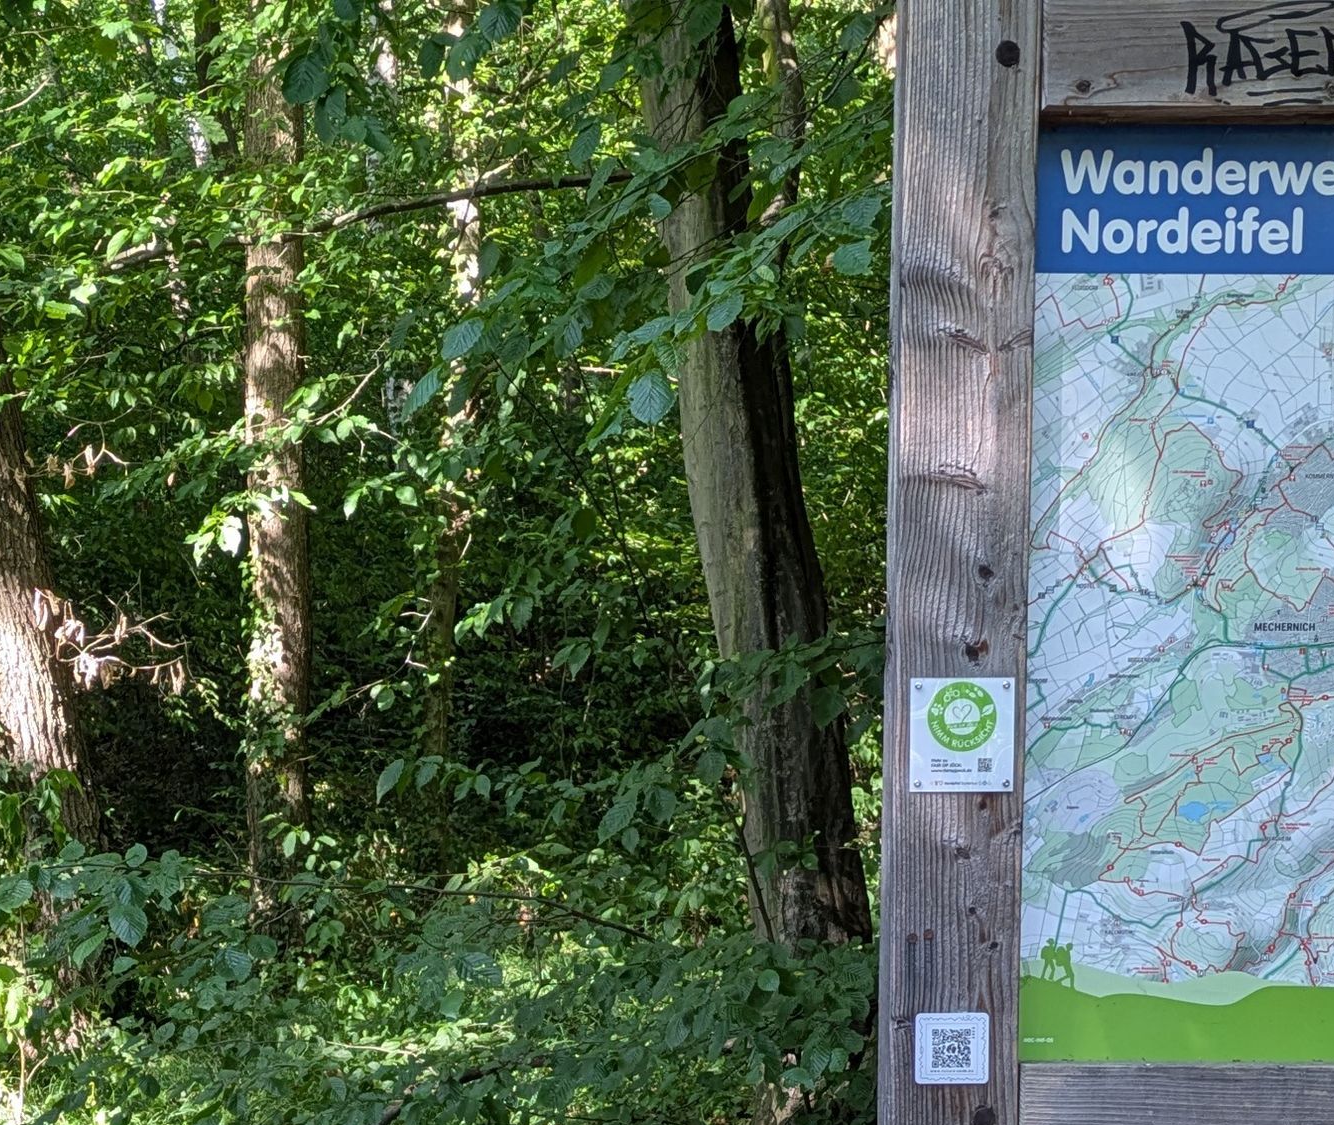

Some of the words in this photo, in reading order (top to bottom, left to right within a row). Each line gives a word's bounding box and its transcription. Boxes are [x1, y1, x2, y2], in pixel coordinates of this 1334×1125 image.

[1061, 206, 1304, 254] Nordeifel
[1253, 622, 1316, 632] MECHERNICH
[931, 720, 950, 744] NIMM
[951, 719, 994, 748] RÜCKSICHT
